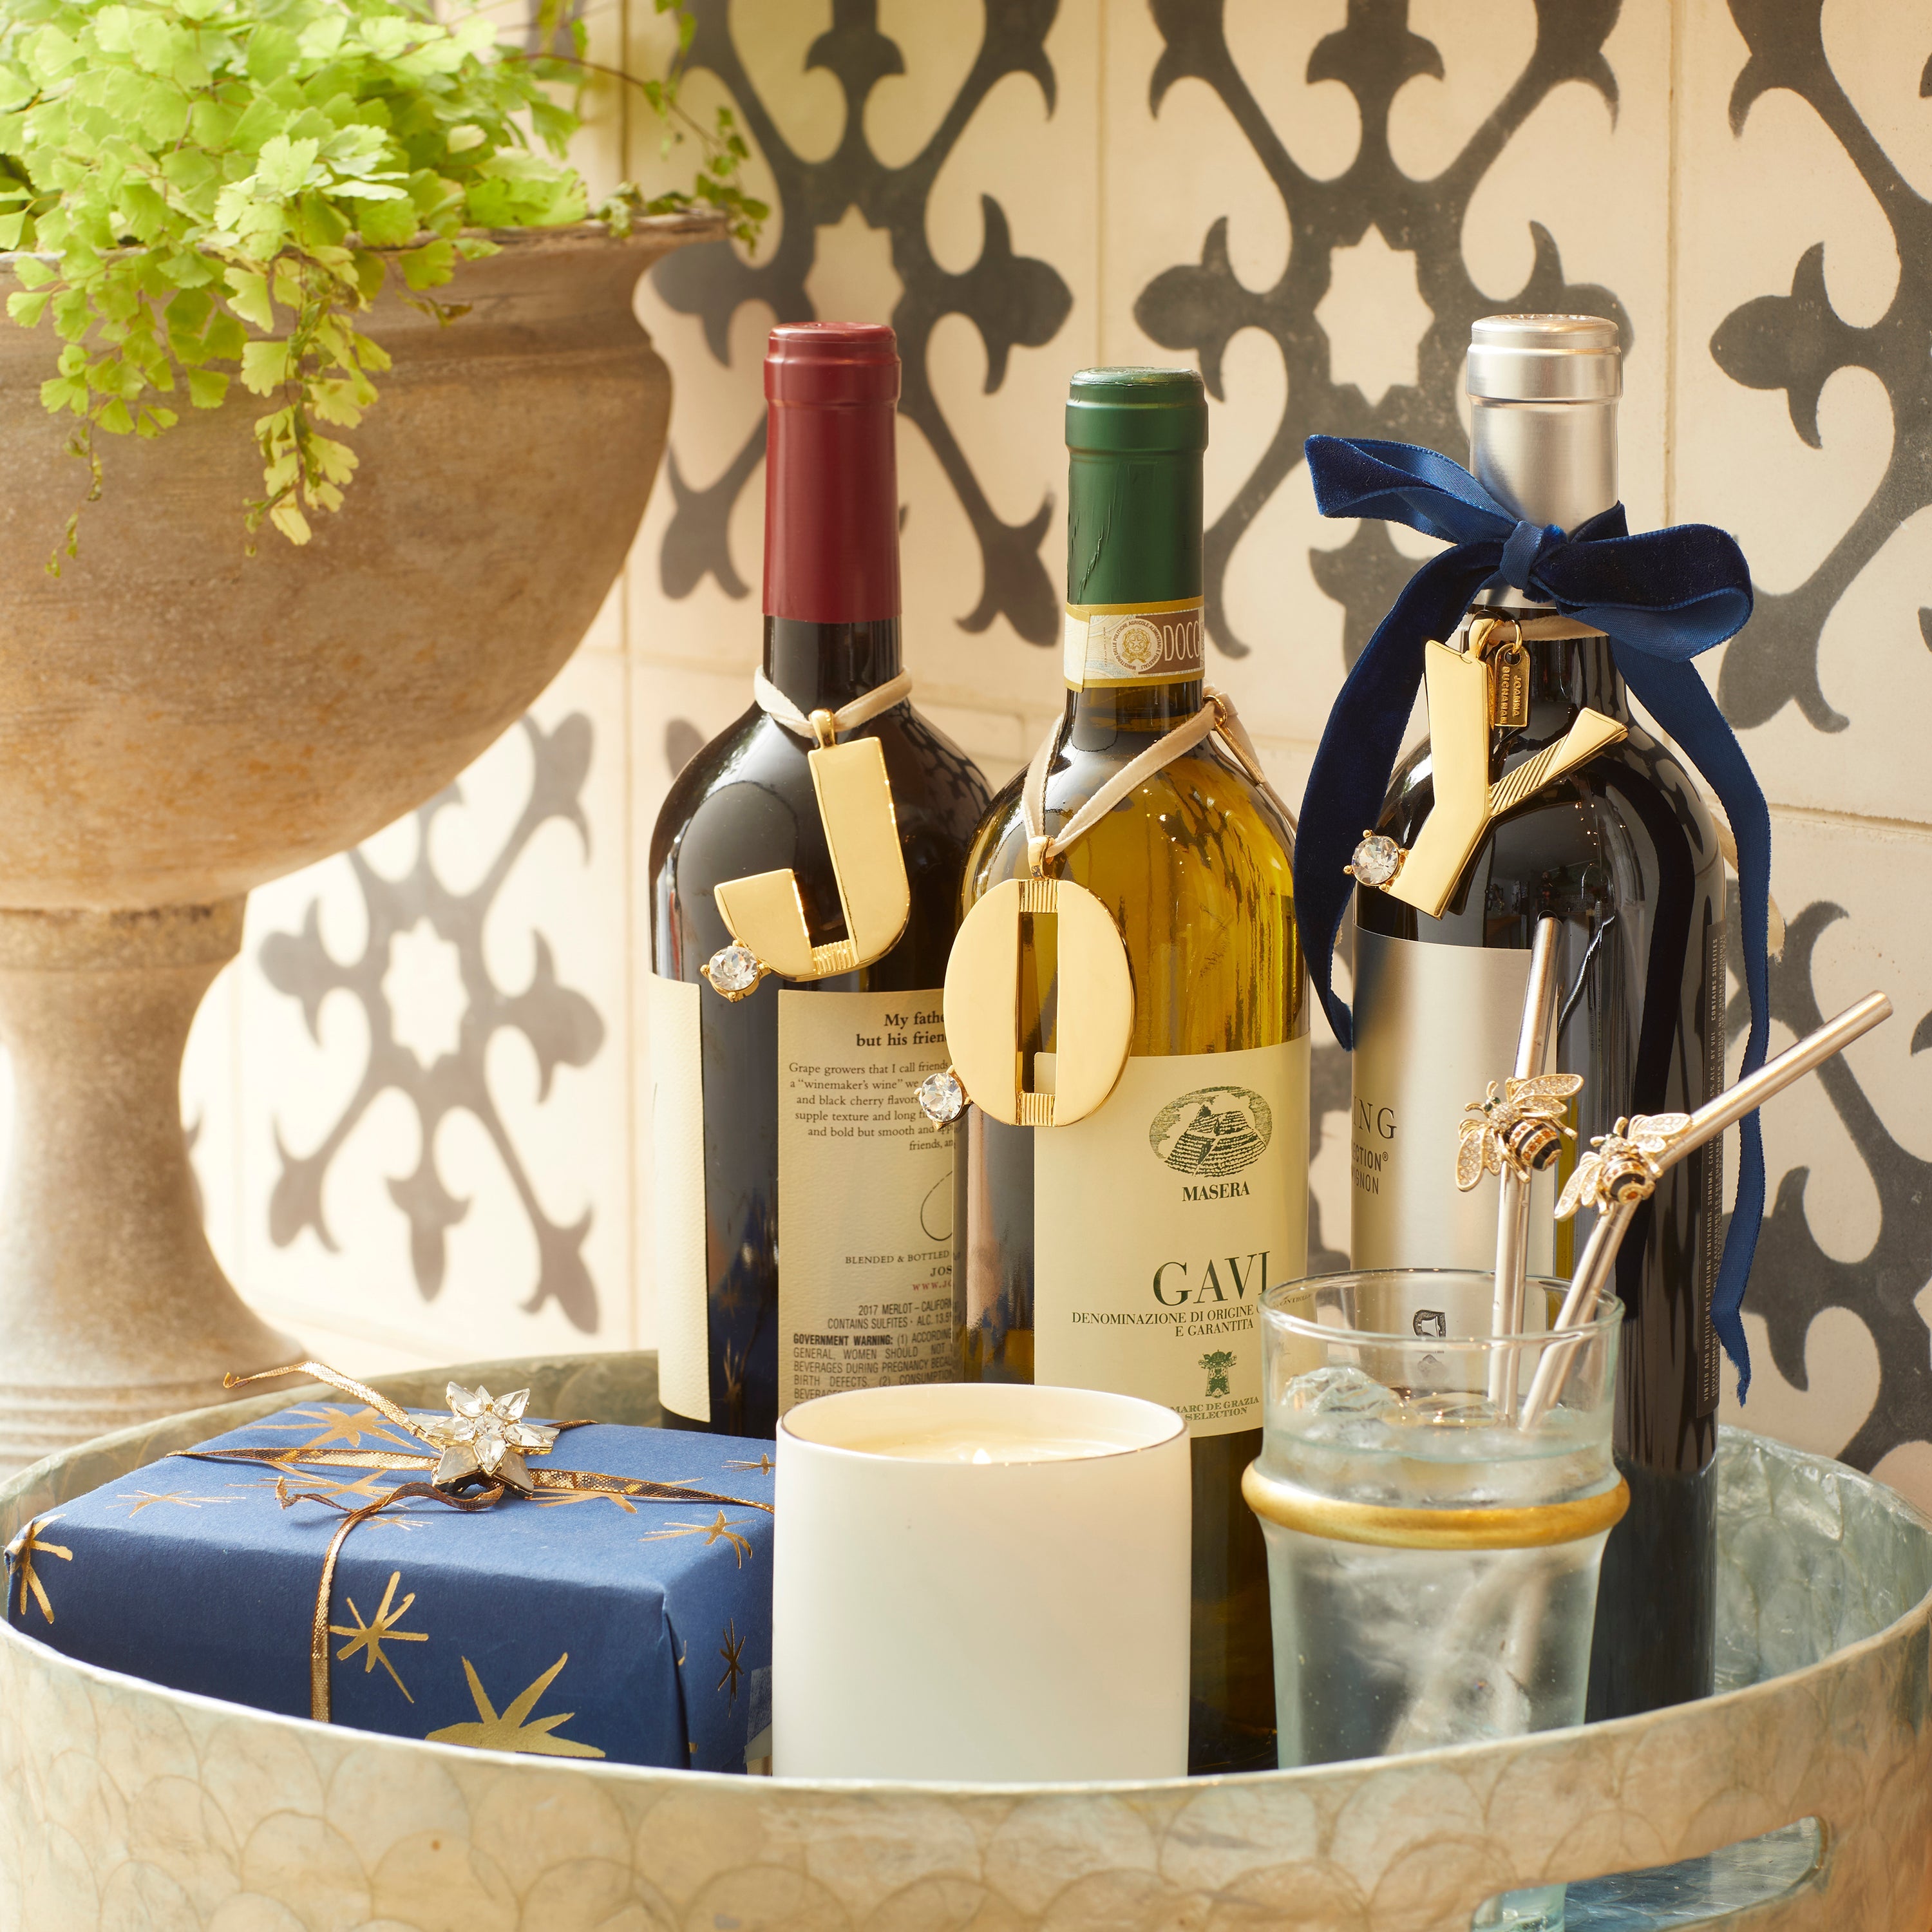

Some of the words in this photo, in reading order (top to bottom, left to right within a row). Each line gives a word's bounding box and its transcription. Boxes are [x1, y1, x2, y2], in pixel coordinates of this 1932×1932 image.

[1113, 623, 1128, 641] POLITICHE
[1500, 666, 1511, 724] BUCHANAN
[1513, 675, 1522, 717] JOANNA
[884, 1014, 908, 1029] My
[857, 1034, 882, 1046] but
[887, 1033, 907, 1046] his
[913, 1031, 947, 1045] frien
[1710, 1050, 1716, 1059] BY
[789, 1063, 820, 1075] Grape
[824, 1065, 866, 1076] growers
[869, 1064, 888, 1074] that
[892, 1064, 896, 1073] I
[899, 1062, 915, 1073] call
[918, 1059, 948, 1072] friends
[797, 1095, 815, 1104] and
[819, 1095, 846, 1105] black
[850, 1096, 884, 1108] cherry
[887, 1095, 919, 1104] flavors
[795, 1110, 828, 1122] supple
[832, 1112, 869, 1121] texture
[873, 1111, 891, 1121] and
[894, 1110, 916, 1122] long
[808, 1126, 826, 1136] and
[831, 1126, 853, 1137] bold
[858, 1127, 875, 1137] but
[878, 1125, 914, 1136] smooth
[918, 1124, 934, 1134] and
[909, 1139, 942, 1150] friends,
[1182, 1180, 1250, 1202] MASERA
[845, 1256, 894, 1264] BLENDED
[907, 1250, 949, 1262] BOTTLED
[1153, 1251, 1271, 1307] GAVI
[858, 1305, 878, 1316] 2017
[882, 1303, 913, 1314] MERLOT
[922, 1298, 952, 1312] CALIFORN
[1705, 1301, 1710, 1311] BY
[828, 1318, 869, 1329] CONTAINS
[871, 1316, 907, 1329] SULFITES
[917, 1314, 933, 1325] ALC.
[1072, 1311, 1186, 1325] DENOMINAZIONE
[1190, 1309, 1204, 1323] DI
[1207, 1305, 1254, 1322] ORIGINE
[1175, 1326, 1184, 1338] E
[1187, 1318, 1255, 1336] GARANTITA
[793, 1333, 849, 1346] GOVERNMENT
[853, 1334, 893, 1346] WARNING:
[897, 1334, 907, 1347] (1)
[793, 1347, 836, 1360] GENERAL,
[844, 1349, 876, 1360] WOMEN
[885, 1346, 918, 1359] SHOULD
[931, 1343, 945, 1355] NOT
[793, 1361, 842, 1374] BEVERAGES
[846, 1362, 879, 1374] DURING
[882, 1359, 929, 1373] PREGNANCY
[931, 1355, 952, 1369] BECAU
[793, 1374, 820, 1386] BIRTH
[829, 1376, 870, 1387] DEFECTS.
[878, 1375, 891, 1387] (2)
[794, 1388, 842, 1399] BEVERA
[1170, 1404, 1204, 1414] MARC
[1206, 1402, 1222, 1411] DE
[1224, 1396, 1260, 1408] GRAZIA
[1185, 1407, 1247, 1421] SELECTION
